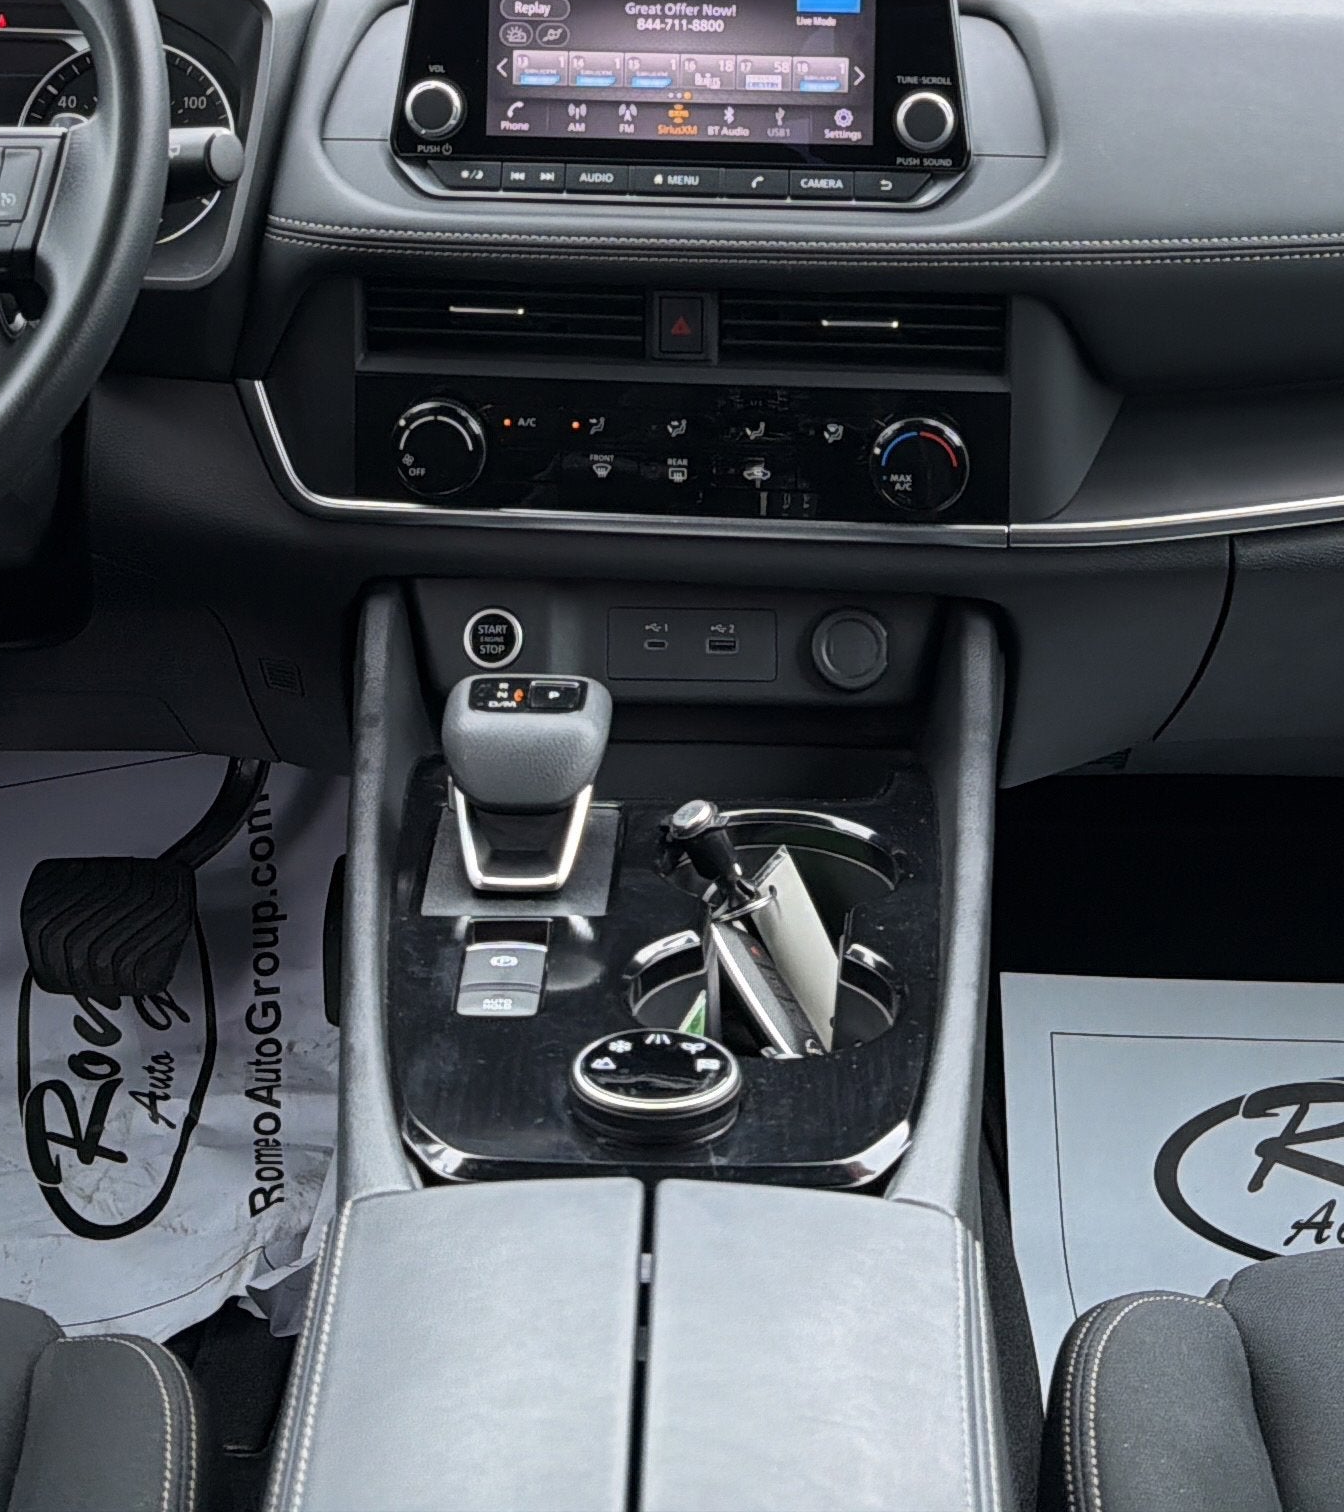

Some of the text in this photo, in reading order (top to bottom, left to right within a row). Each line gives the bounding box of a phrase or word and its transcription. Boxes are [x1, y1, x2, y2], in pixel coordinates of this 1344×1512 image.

[514, 0, 551, 17] Replay
[625, 2, 737, 17] Great Offer Now!
[637, 18, 724, 32] 844-711-8800
[813, 18, 836, 27] Mode
[429, 65, 445, 74] VOL
[718, 60, 734, 72] 18
[774, 61, 790, 73] 58
[58, 95, 77, 109] 40
[183, 96, 207, 110] 100
[500, 120, 529, 131] Phone
[568, 123, 586, 132] AM
[619, 124, 635, 133] FM
[657, 124, 698, 135] SiriusXM
[708, 126, 750, 137] BT Audio
[767, 128, 790, 137] USB1
[824, 129, 862, 141] Settings
[417, 144, 441, 154] PUSH
[897, 157, 952, 167] PUSH SOUND
[579, 173, 614, 183] AUDIO
[668, 175, 700, 185] MENU
[801, 179, 844, 189] CAMERA
[517, 417, 537, 428] A/C
[589, 454, 614, 462] FRONT
[667, 458, 688, 466] REAR
[408, 467, 427, 477] OFF
[889, 473, 912, 482] MAX
[894, 481, 912, 492] A/C
[478, 624, 508, 634] START
[728, 624, 735, 634] 2
[479, 645, 505, 654] STOP
[548, 691, 560, 700] P
[244, 791, 288, 1218] RomeoAutoGroup.com
[129, 1050, 176, 1129] Auto
